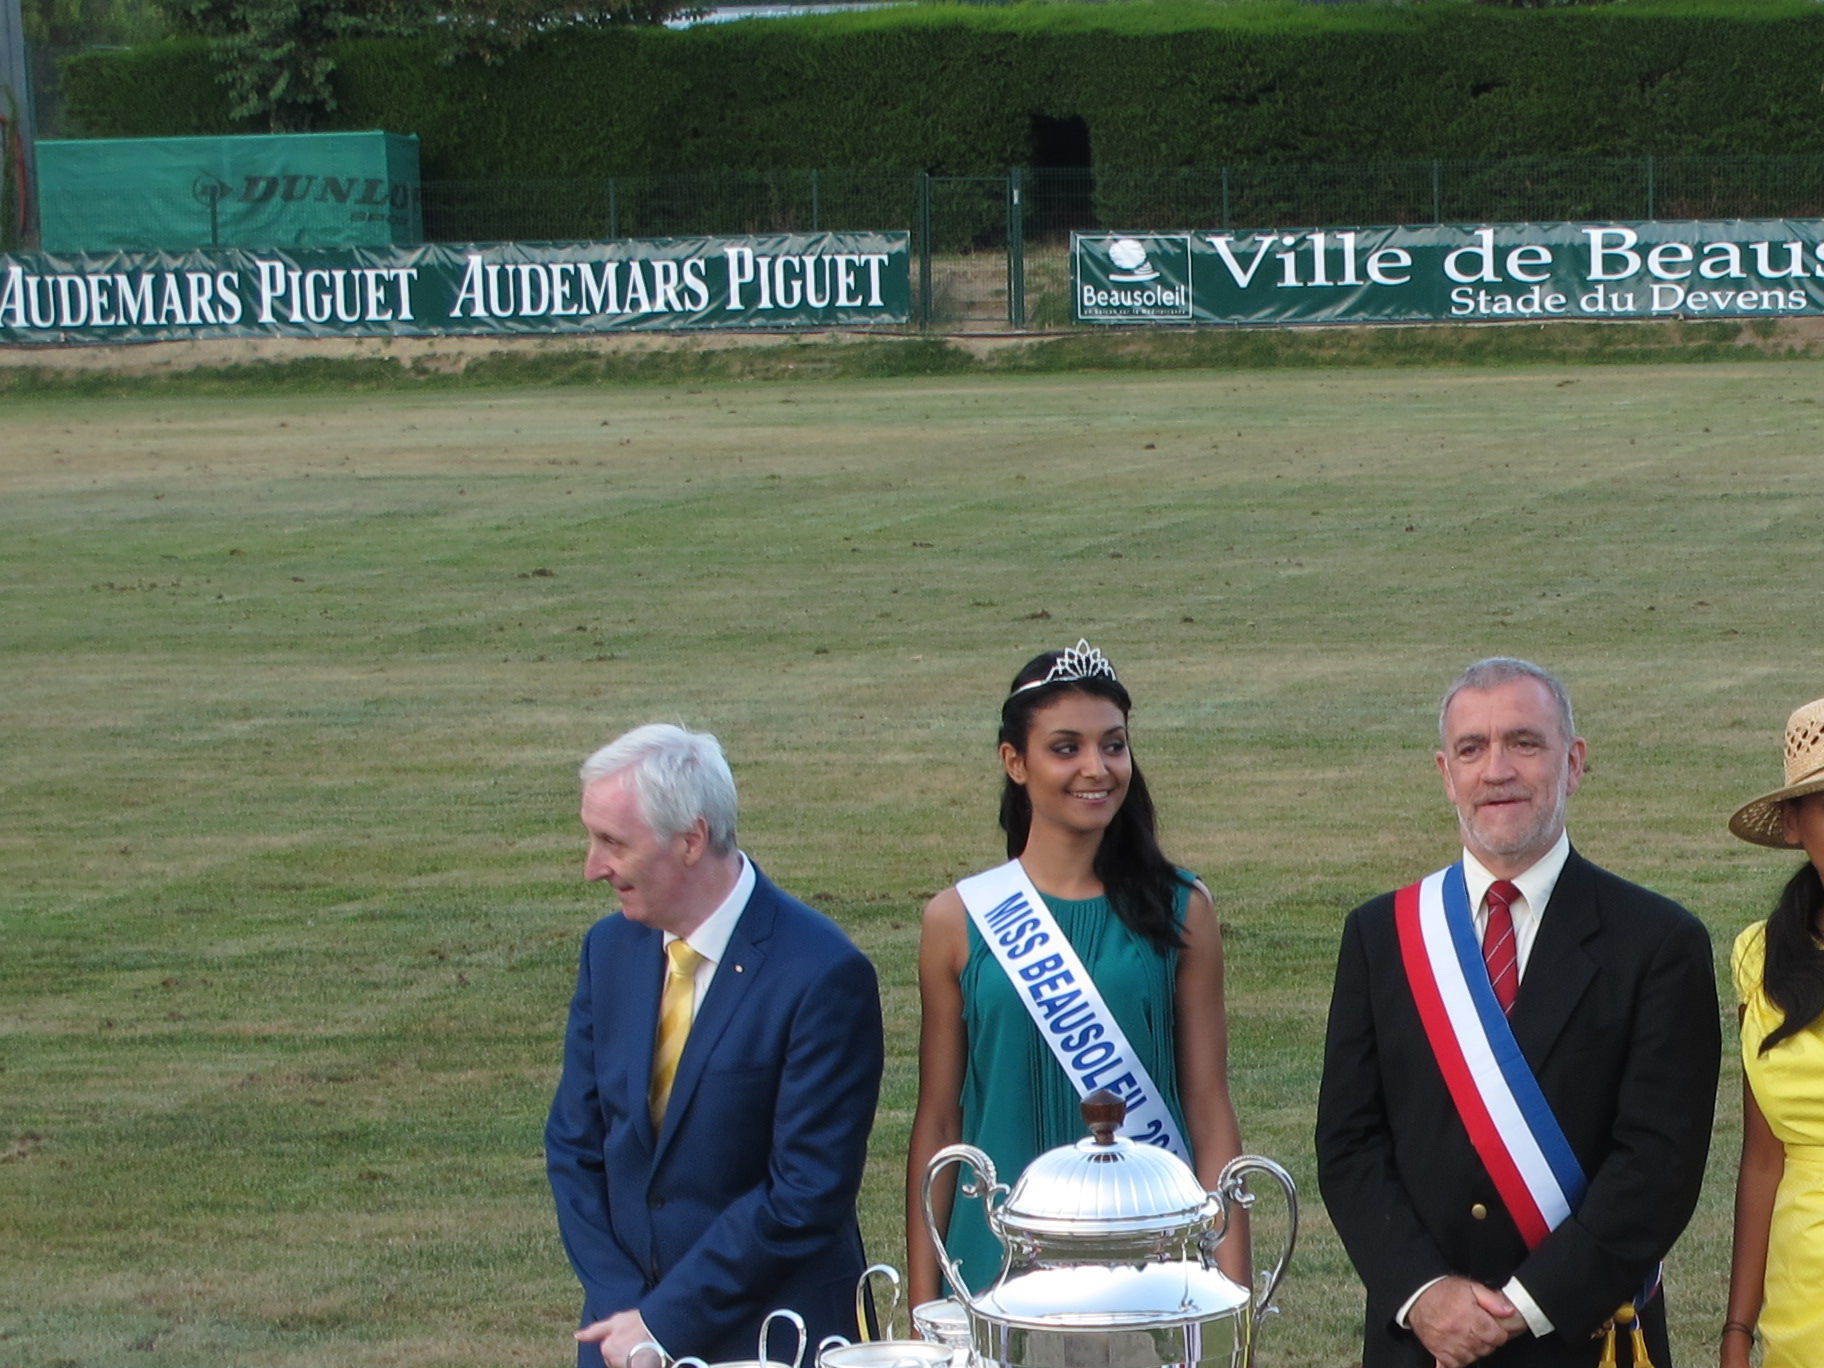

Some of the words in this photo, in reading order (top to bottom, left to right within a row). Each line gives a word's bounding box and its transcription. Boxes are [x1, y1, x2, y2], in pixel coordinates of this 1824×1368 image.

[449, 254, 709, 318] AUDEMARS
[724, 246, 889, 311] PIGUET
[1205, 231, 1413, 289] Ville
[1443, 228, 1553, 286] de
[0, 265, 242, 329] AUDEMARS
[256, 260, 418, 324] PIGUET
[1083, 284, 1187, 308] Beausoleil
[1450, 286, 1567, 316] Stade
[1580, 284, 1637, 313] du
[1648, 283, 1808, 312] Devens
[983, 890, 1050, 961] MISS
